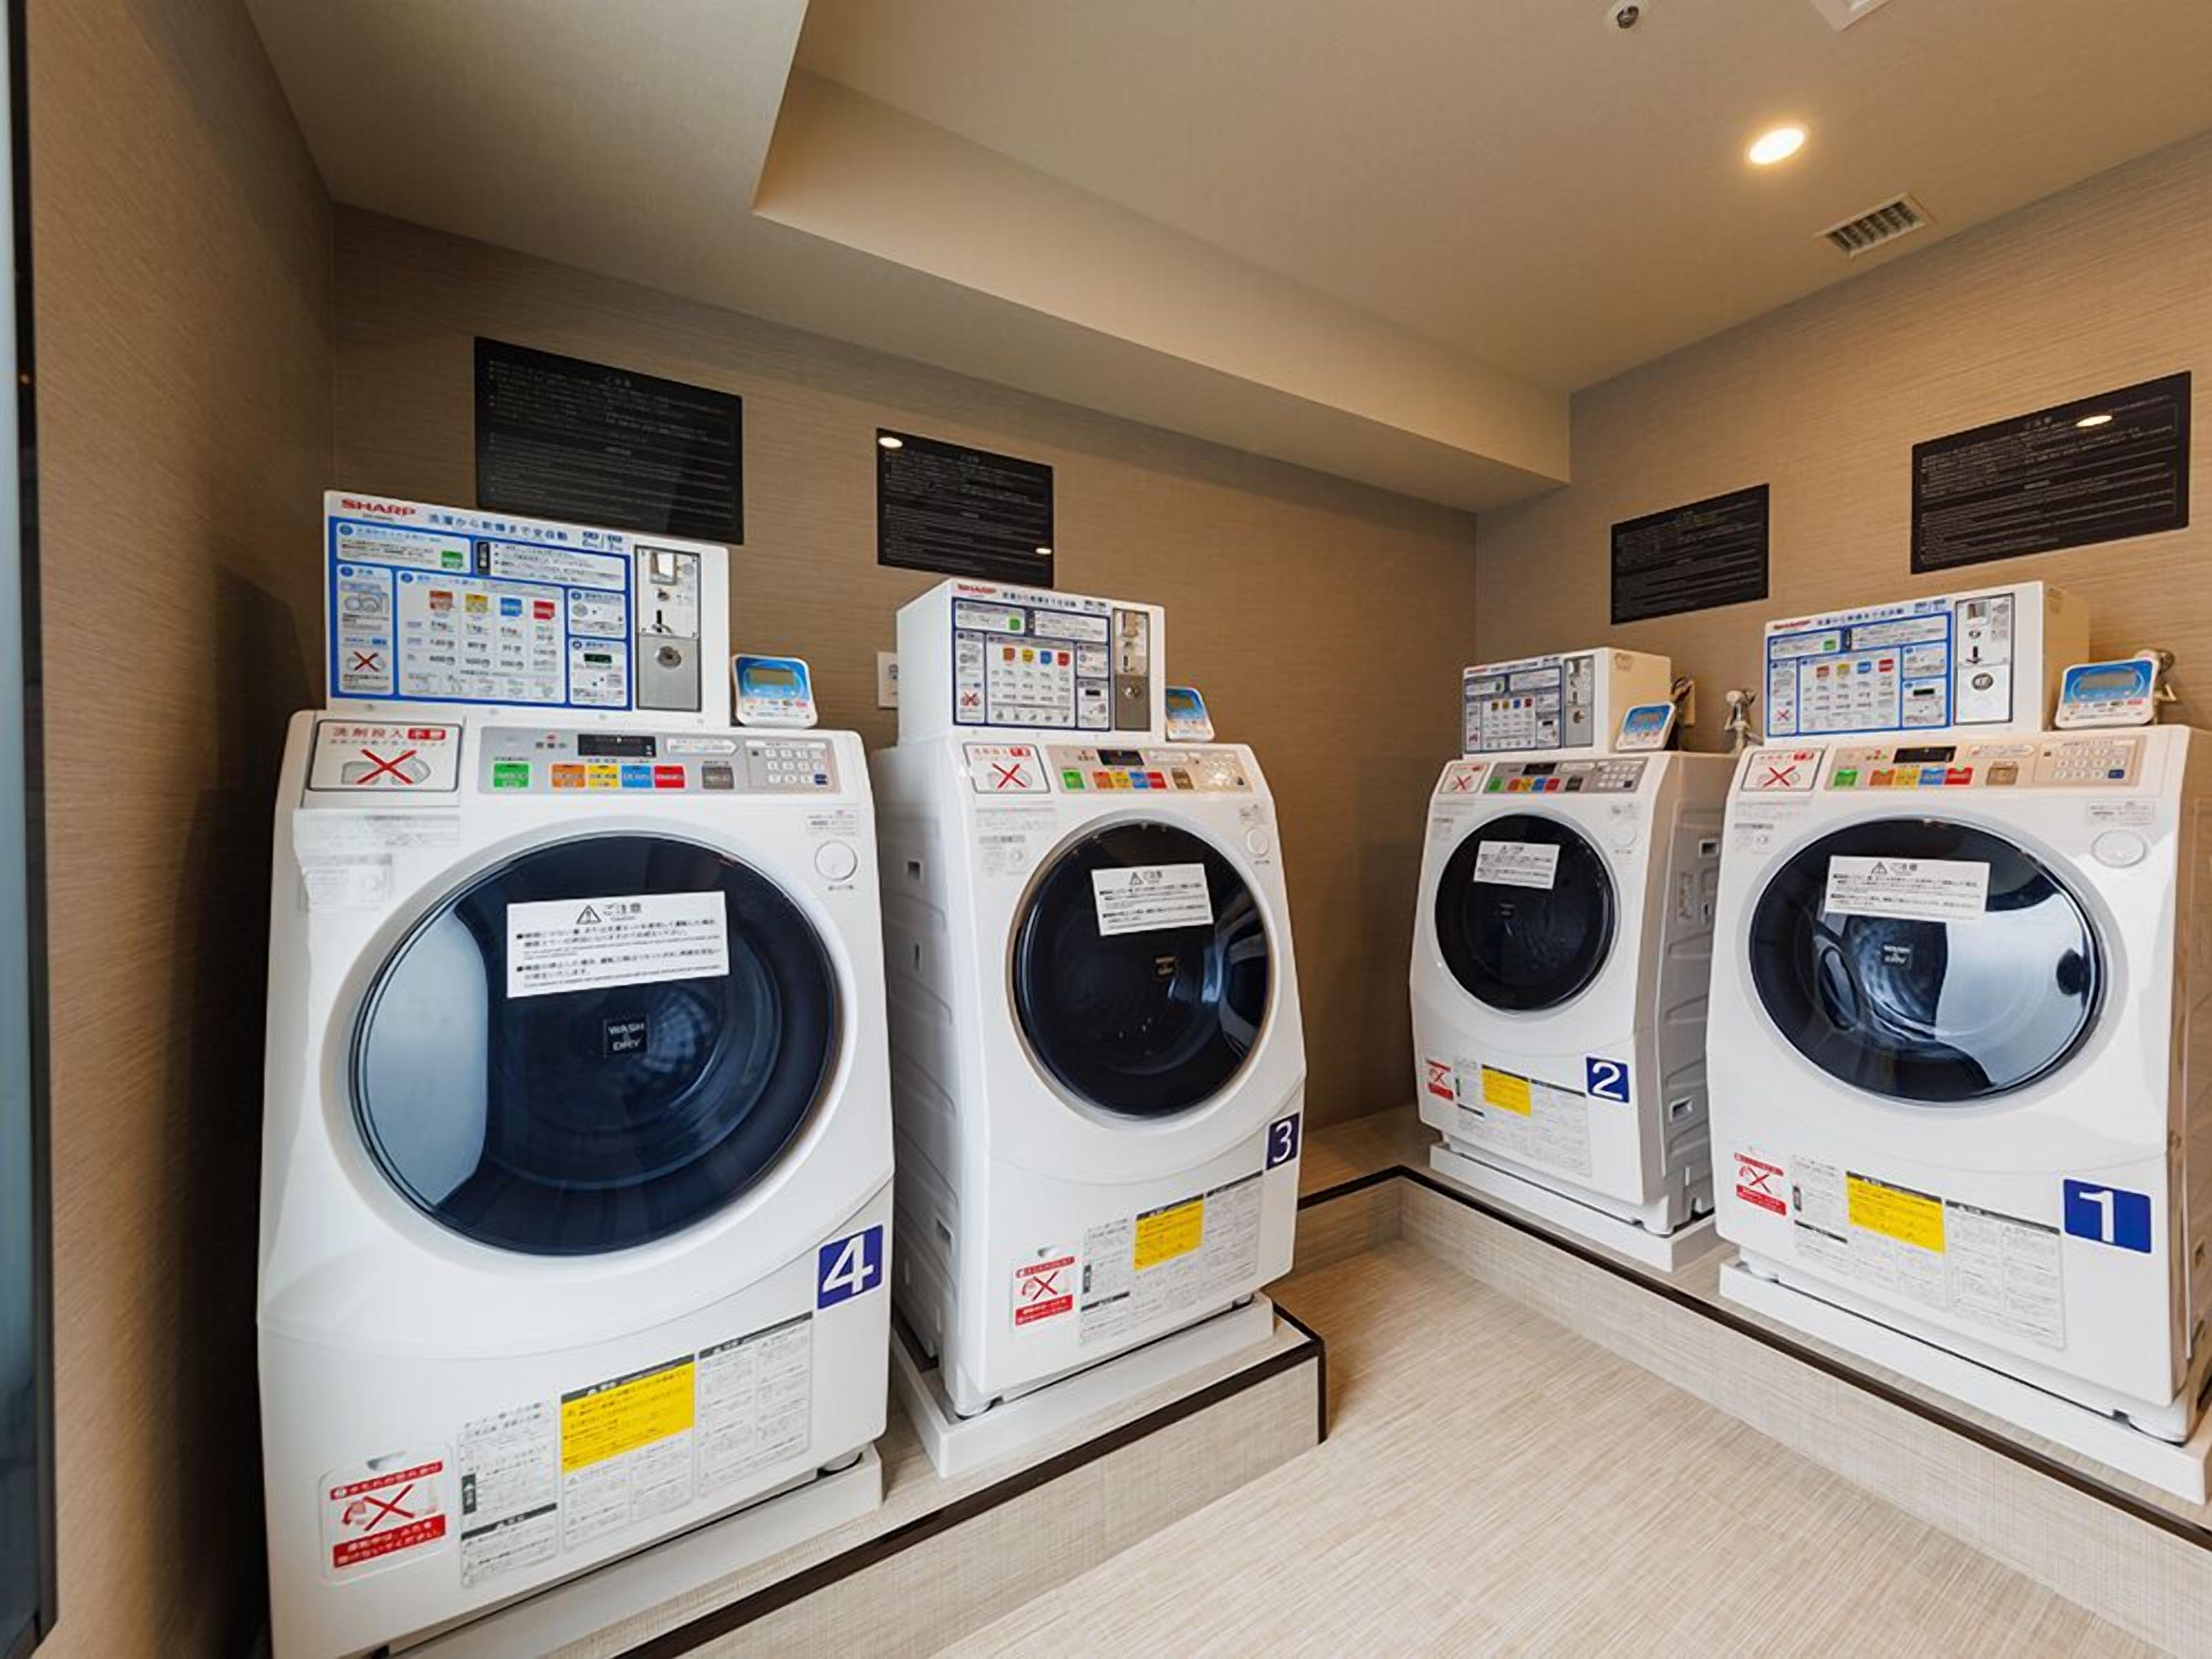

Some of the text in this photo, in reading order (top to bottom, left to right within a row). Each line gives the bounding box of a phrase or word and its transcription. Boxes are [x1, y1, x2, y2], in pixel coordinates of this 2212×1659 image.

[341, 499, 416, 516] SHARP
[1592, 1061, 1623, 1100] 2
[1273, 1120, 1292, 1162] 3
[2079, 1190, 2114, 1244] 1
[822, 1233, 874, 1295] 4
